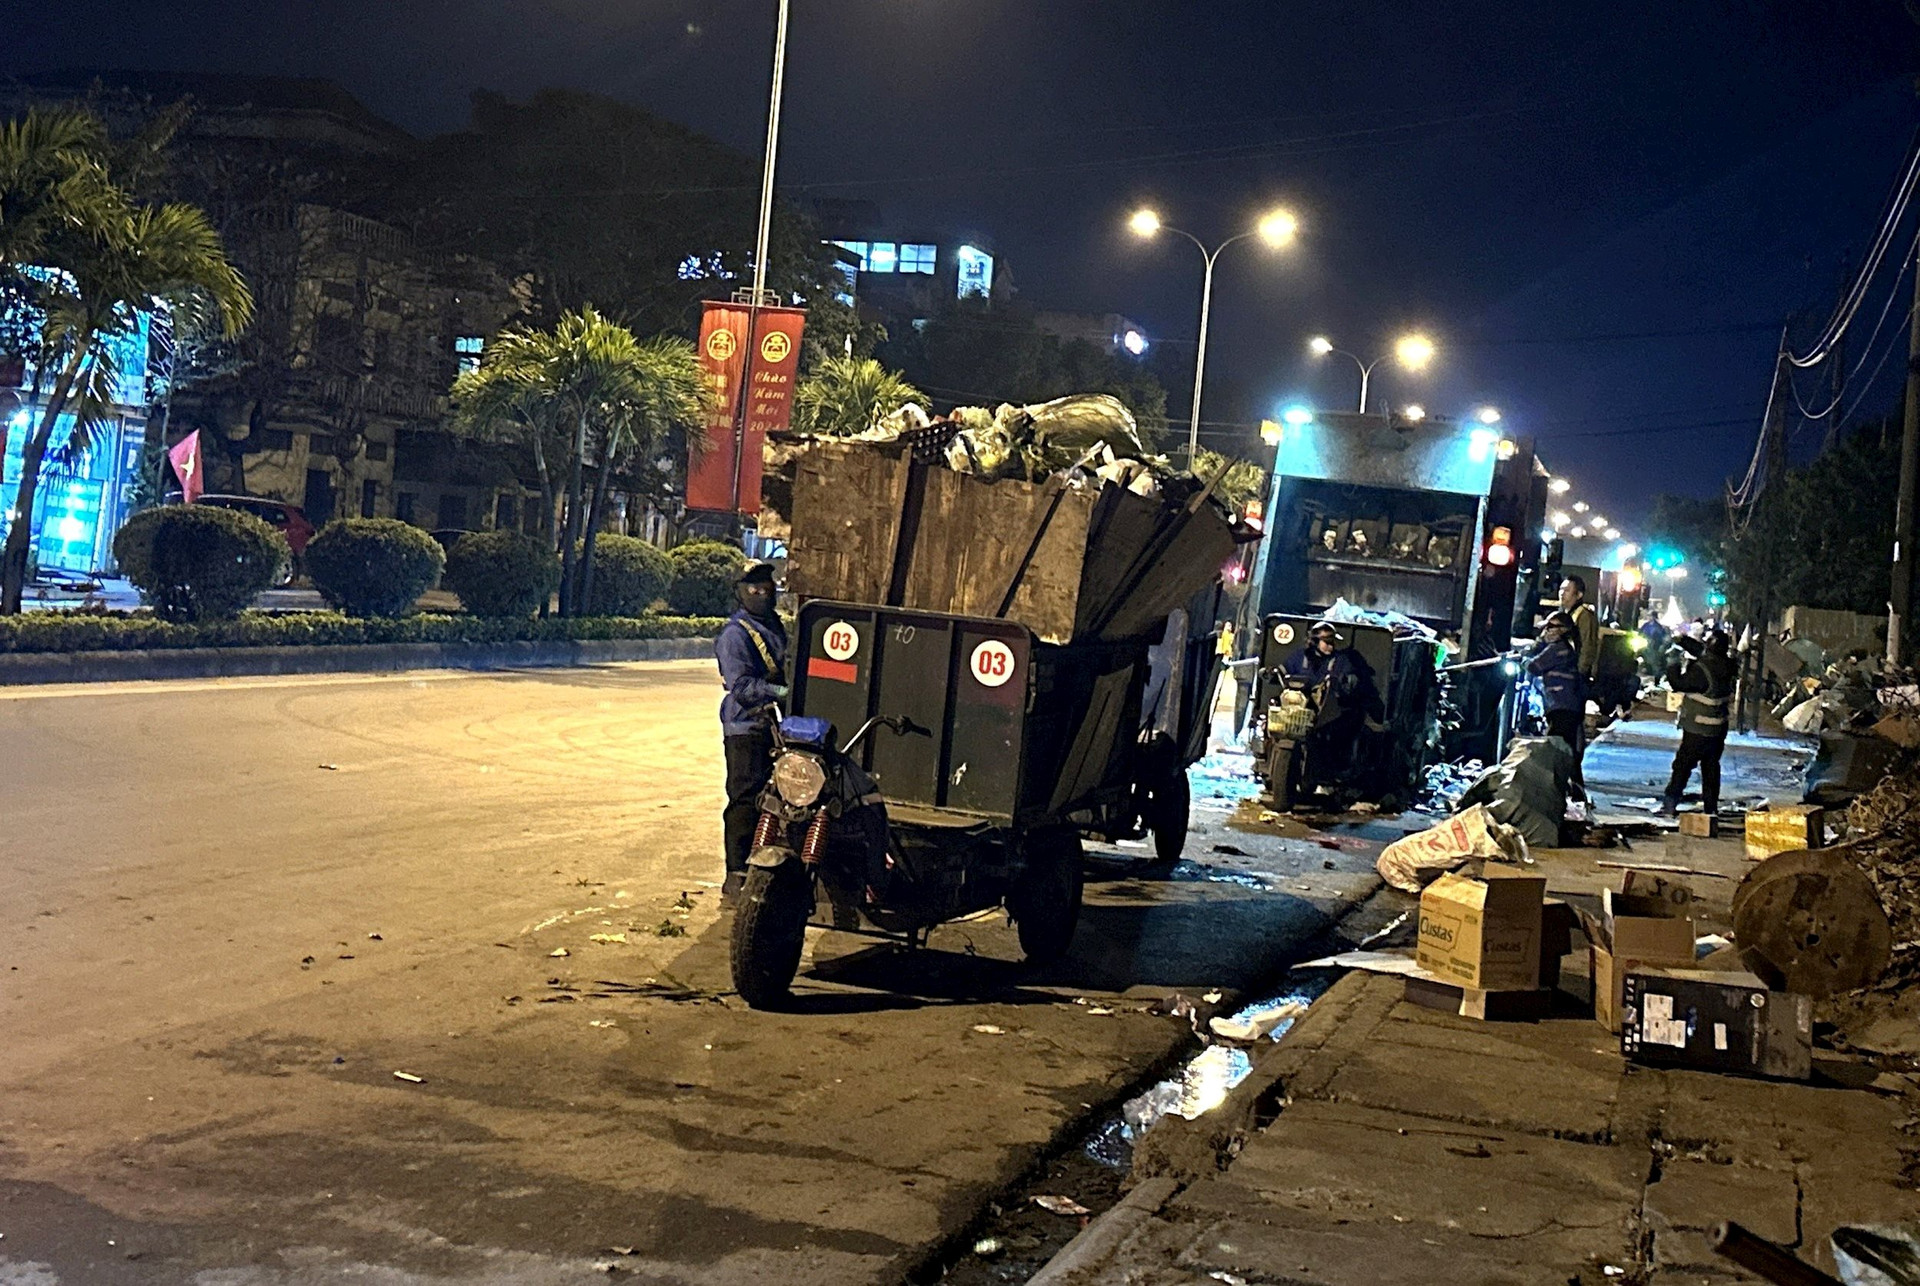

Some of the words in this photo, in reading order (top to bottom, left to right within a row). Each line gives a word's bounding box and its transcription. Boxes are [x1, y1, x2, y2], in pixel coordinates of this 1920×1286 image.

[829, 631, 851, 652] 03
[1277, 628, 1290, 640] 22
[978, 650, 1007, 676] 03
[1420, 916, 1454, 943] Custas
